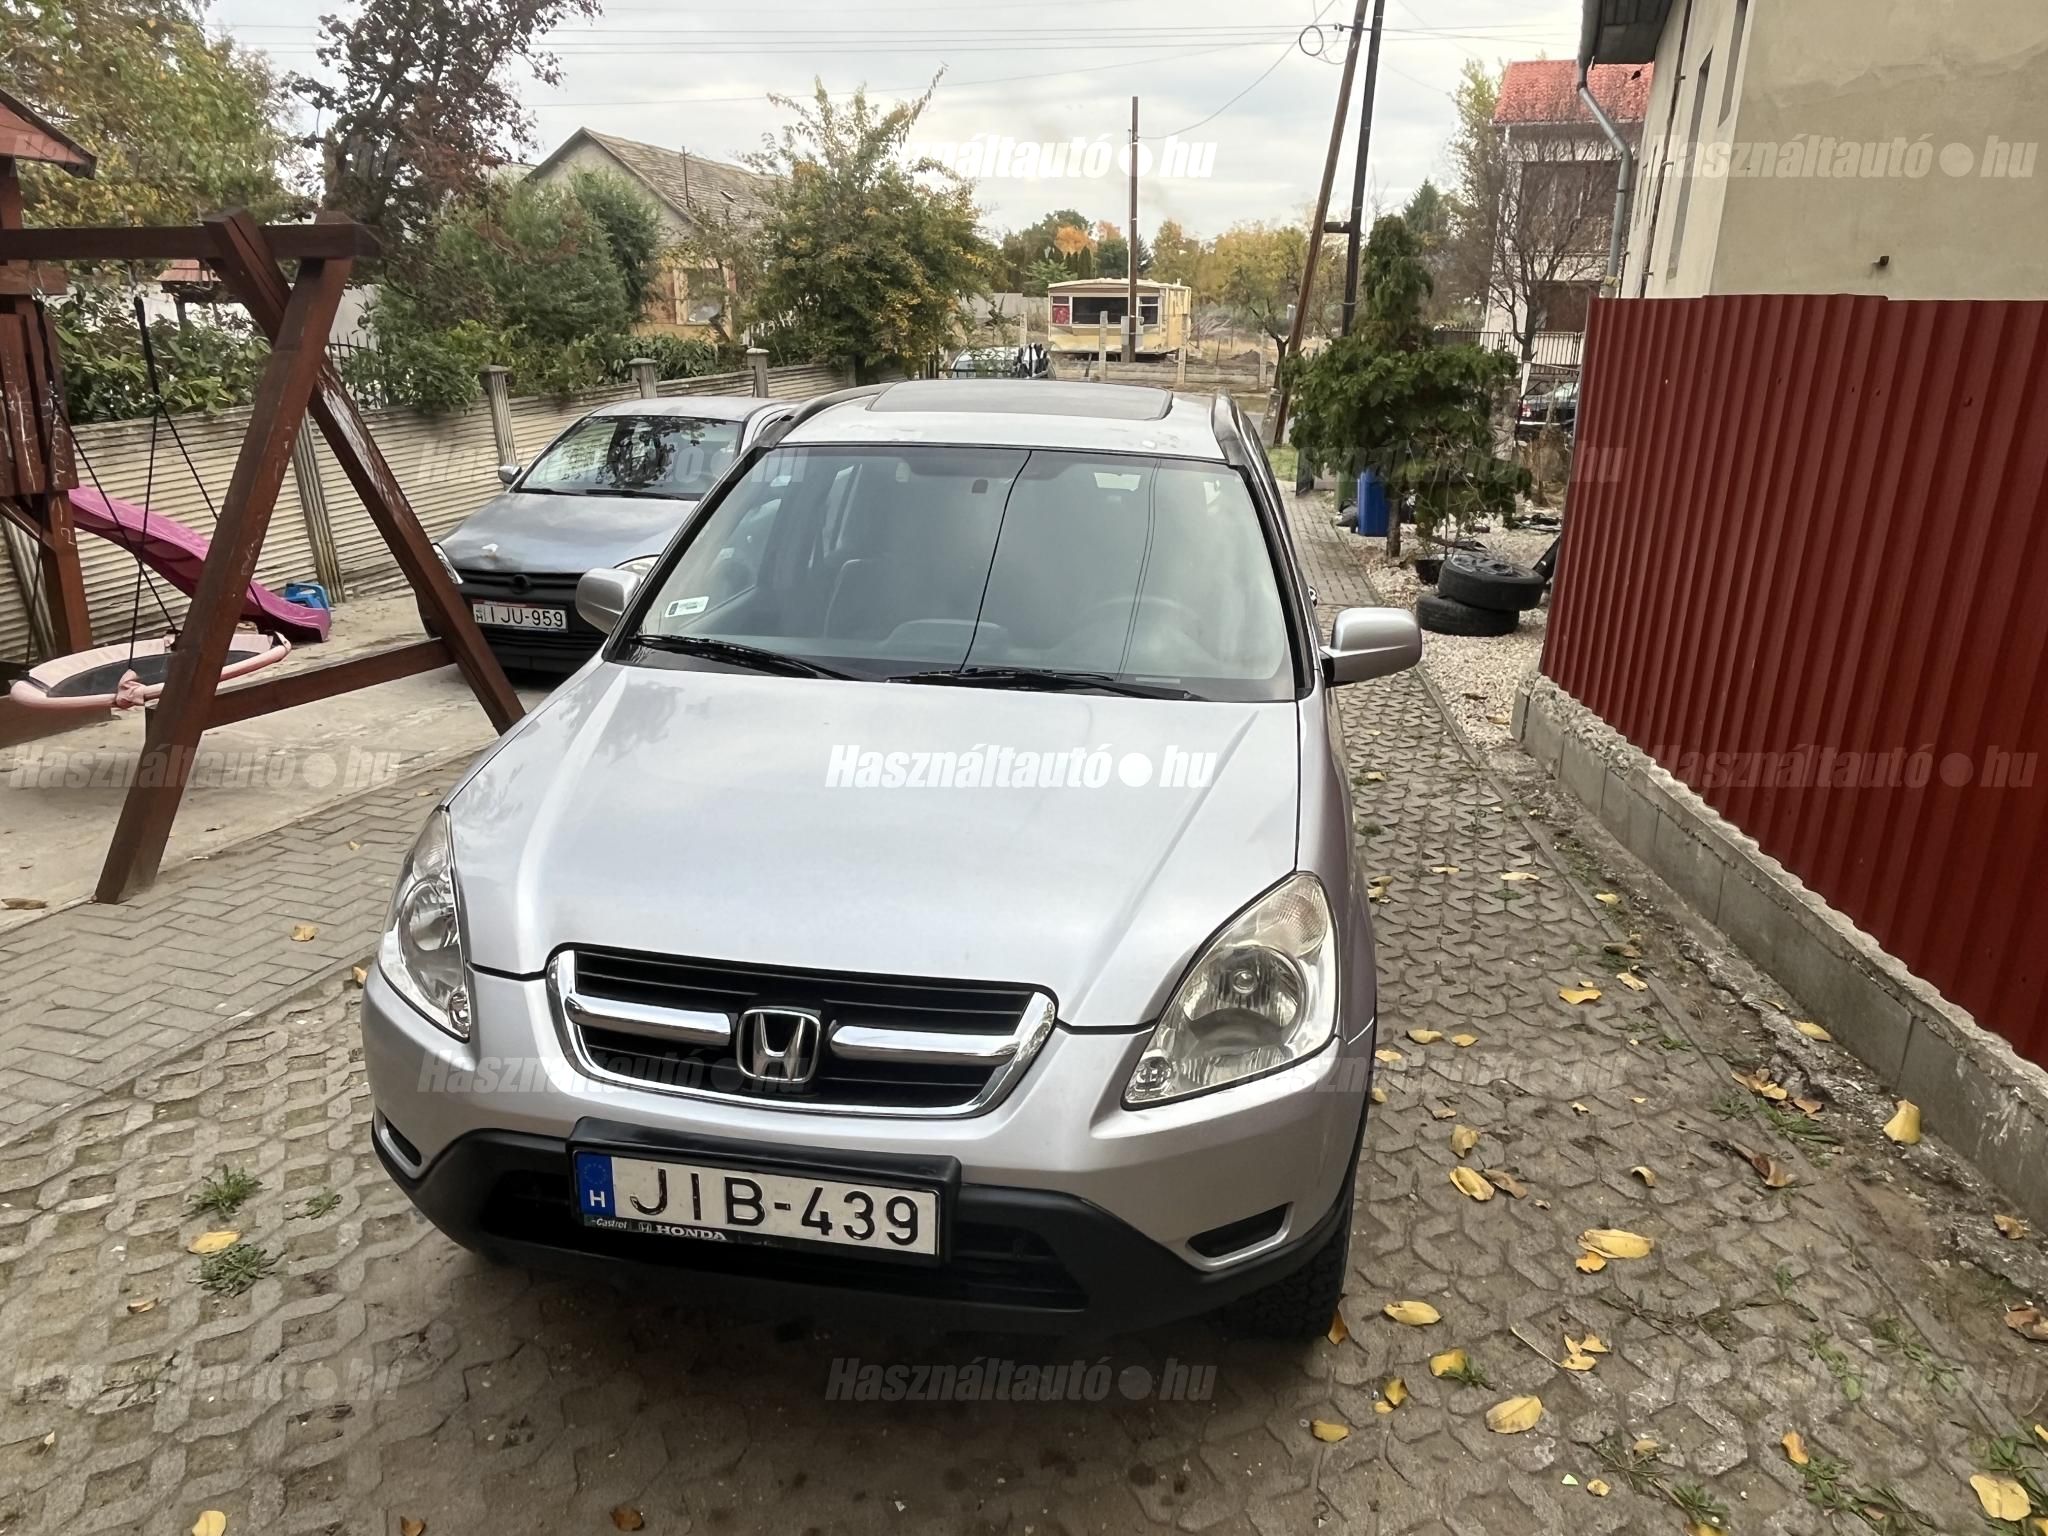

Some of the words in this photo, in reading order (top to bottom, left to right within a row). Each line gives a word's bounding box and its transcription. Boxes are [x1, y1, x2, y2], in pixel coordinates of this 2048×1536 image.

[490, 606, 563, 627] IJU-959
[589, 1189, 606, 1208] H
[629, 1168, 919, 1247] JIB-439
[595, 1217, 628, 1230] Castrol
[655, 1224, 728, 1241] HONDA
